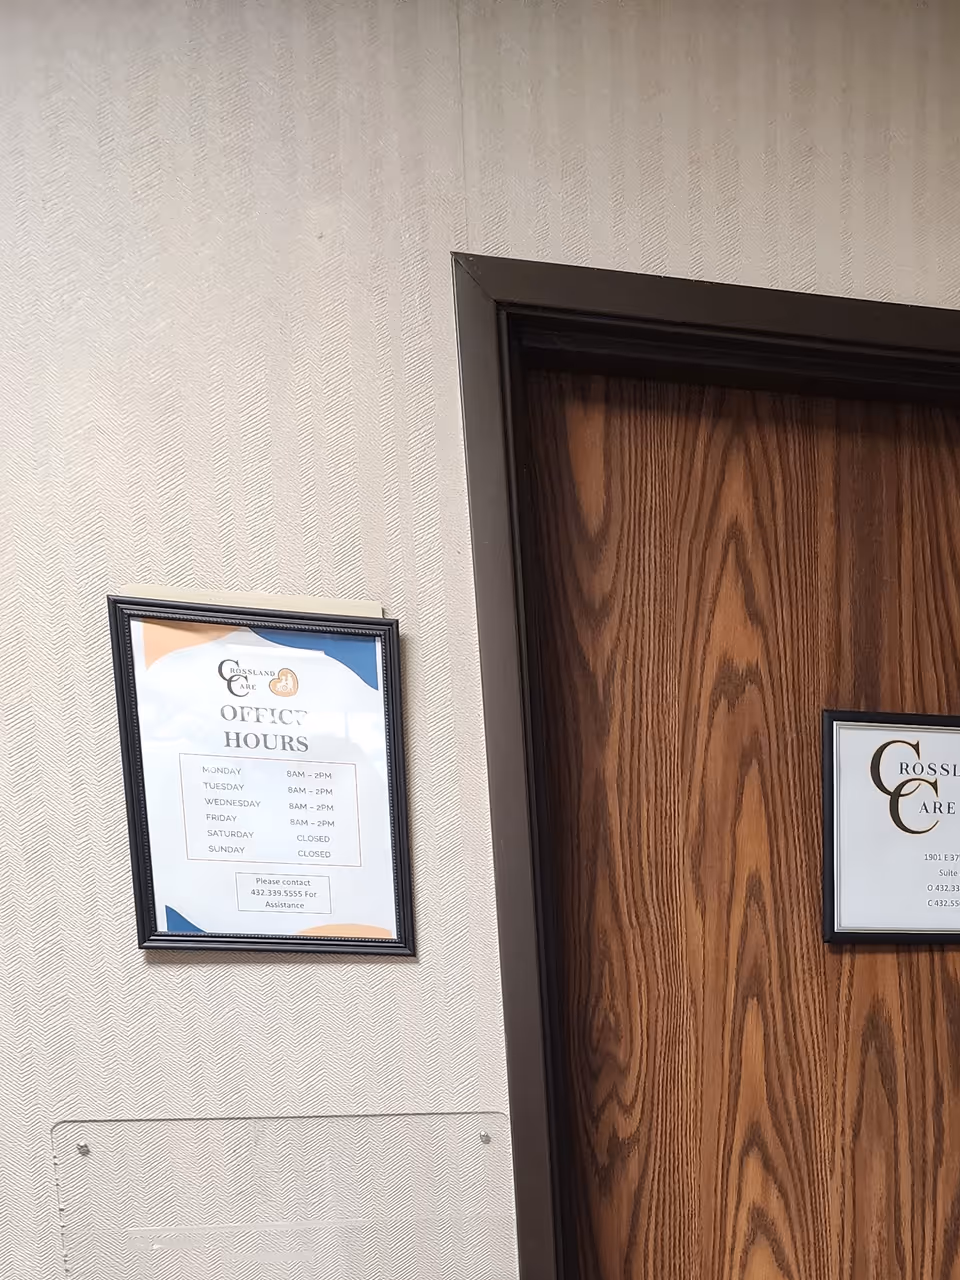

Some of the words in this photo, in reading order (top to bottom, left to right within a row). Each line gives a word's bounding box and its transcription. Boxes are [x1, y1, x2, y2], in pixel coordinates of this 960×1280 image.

[217, 659, 276, 682] CROSSLAND
[227, 674, 257, 698] CARE
[224, 731, 309, 752] HOURS
[202, 766, 242, 775] MONDAY
[286, 770, 305, 778] 8AM
[314, 772, 332, 780] 2PM
[203, 782, 244, 791] TUESDAY
[287, 786, 307, 794] 8AM
[315, 788, 333, 796] 2PM
[204, 798, 261, 808] WEDNESDAY
[889, 778, 957, 835] CARE
[206, 813, 237, 822] FRIDAY
[317, 820, 335, 828] 2PM
[207, 829, 255, 839] SATURDAY
[296, 835, 331, 843] CLOSED
[208, 845, 246, 854] SUNDAY
[297, 850, 332, 859] CLOSED
[924, 853, 942, 861] 1901
[939, 869, 958, 877] Suite
[255, 878, 281, 886] Please
[282, 879, 312, 887] contact
[250, 889, 303, 898] 432.339.5555
[265, 901, 305, 909] Assistance
[927, 899, 933, 907] C
